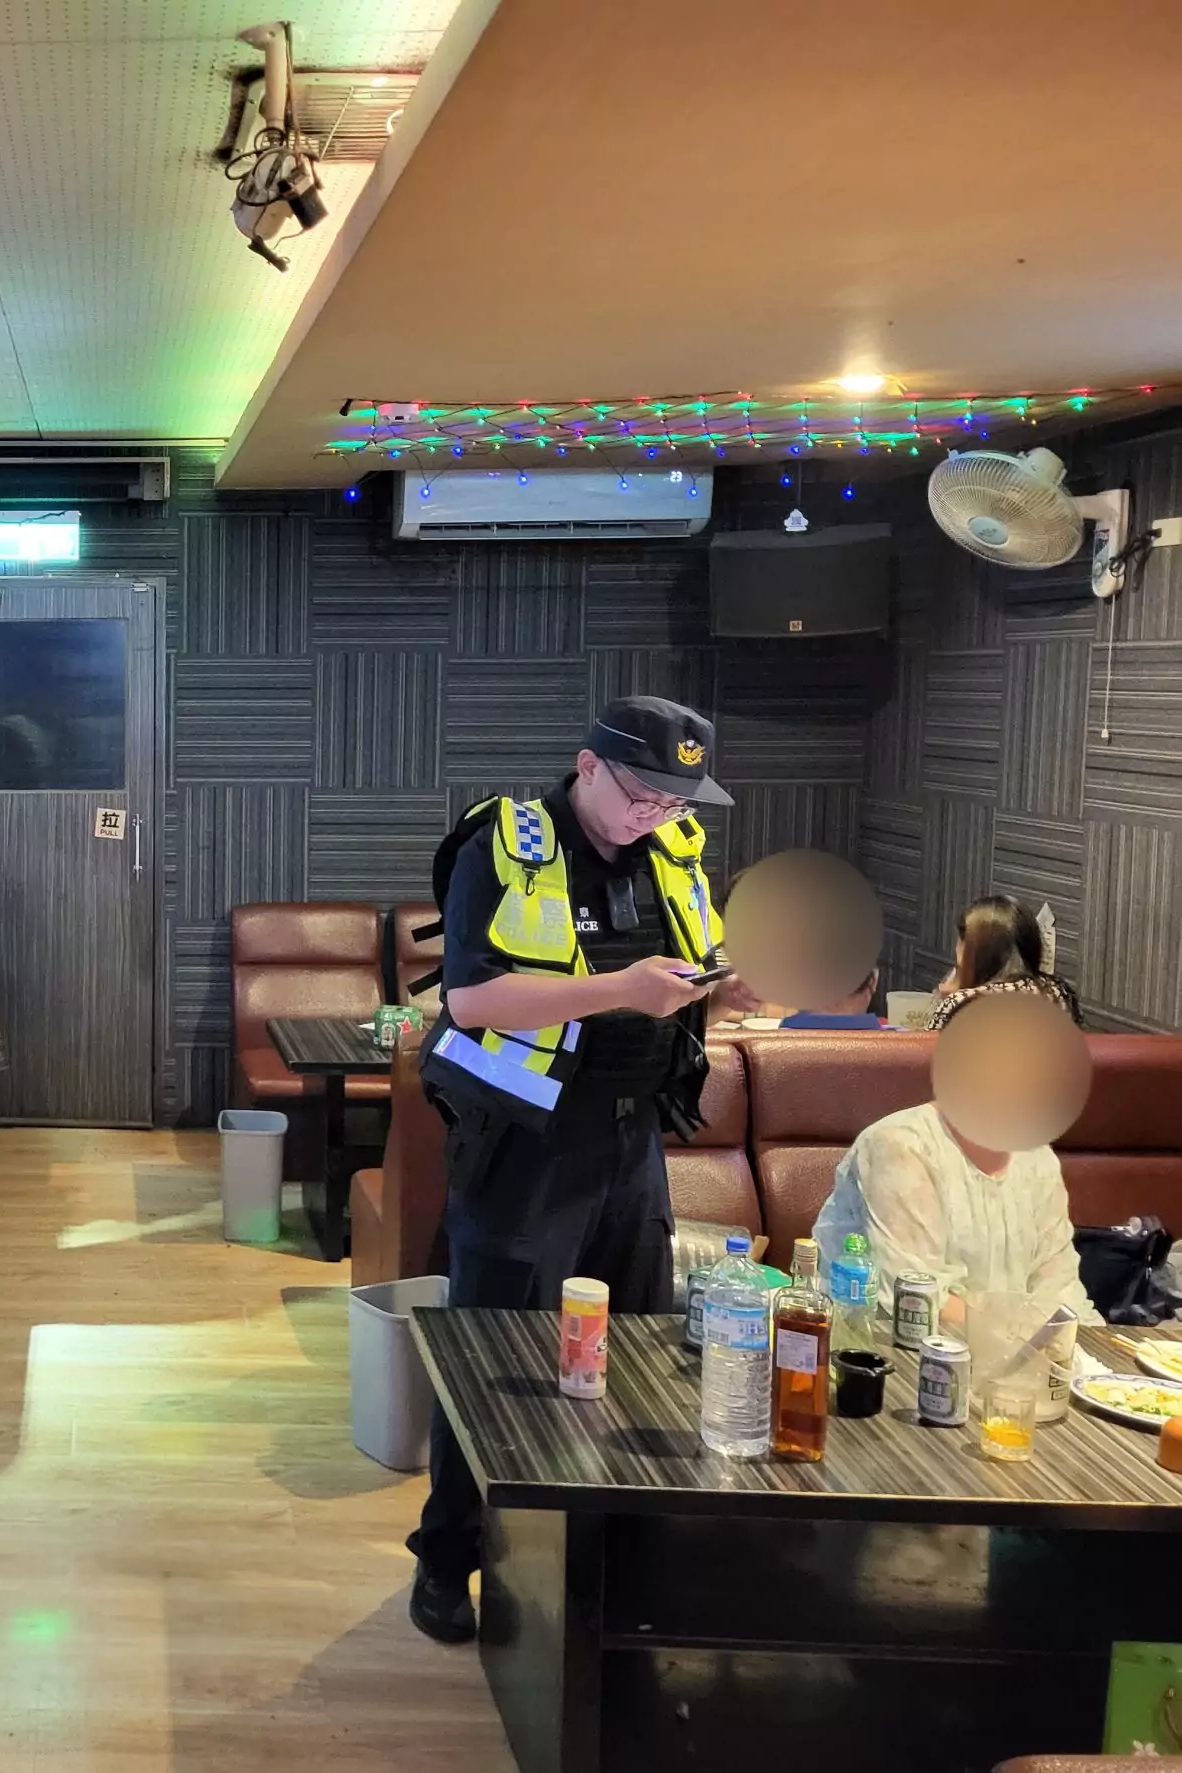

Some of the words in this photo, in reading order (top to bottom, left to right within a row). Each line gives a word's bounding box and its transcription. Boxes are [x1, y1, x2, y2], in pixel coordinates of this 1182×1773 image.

[101, 811, 120, 829] 拉
[99, 828, 119, 837] PULL
[575, 921, 598, 931] ICE
